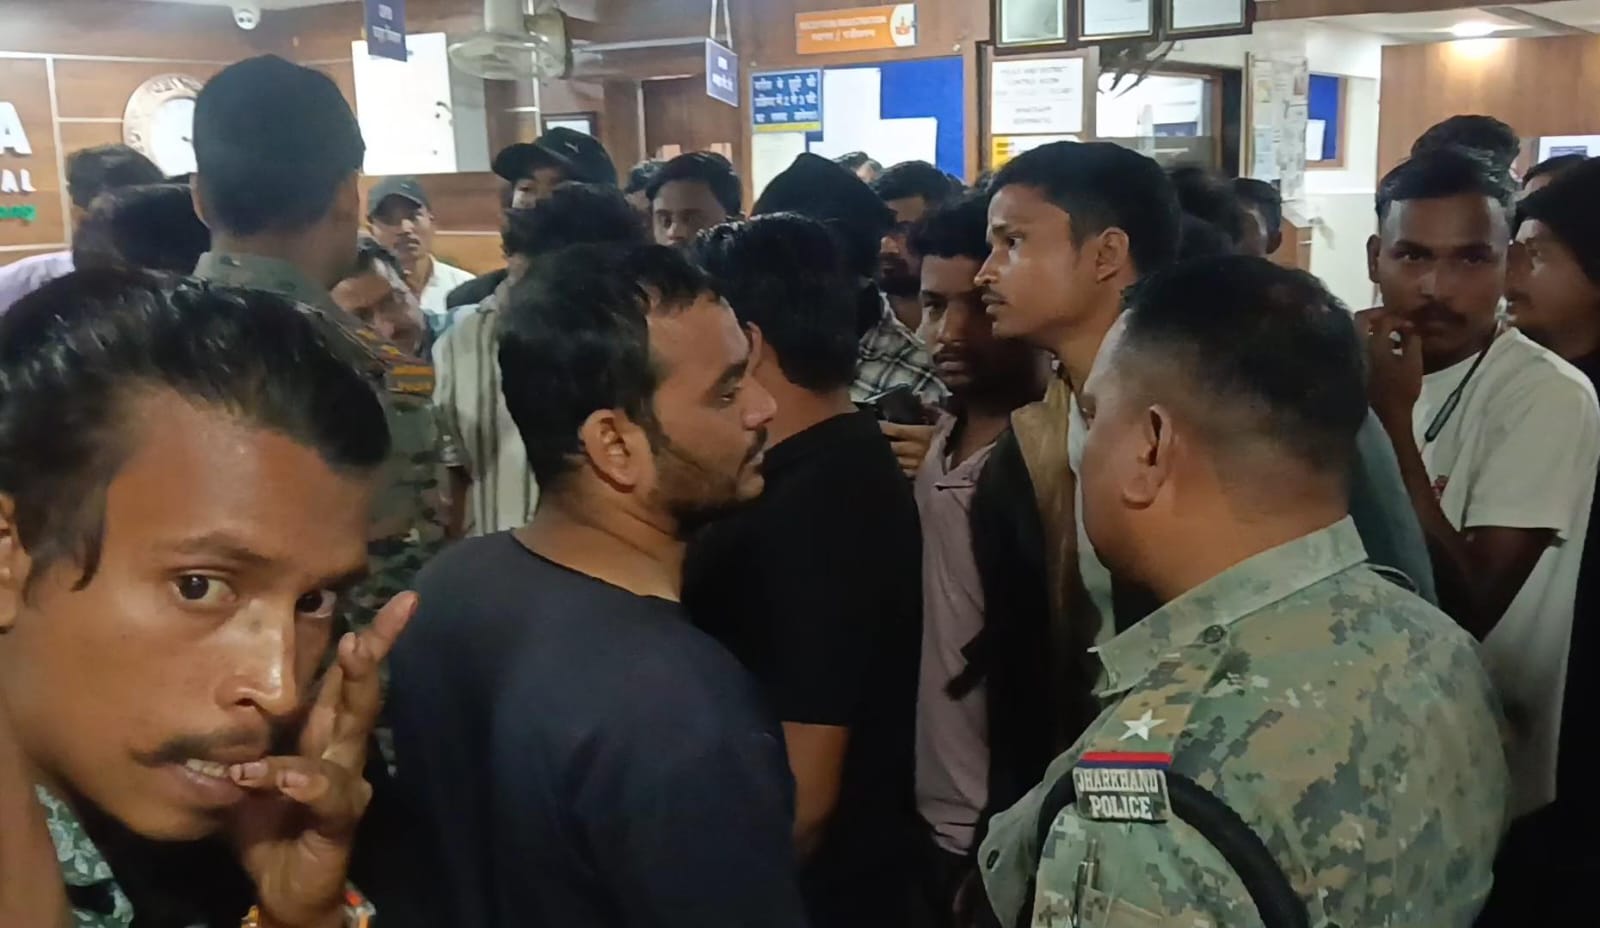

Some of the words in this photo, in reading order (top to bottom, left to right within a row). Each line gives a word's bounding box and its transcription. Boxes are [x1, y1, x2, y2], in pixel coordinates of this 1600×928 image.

[0, 101, 32, 154] A
[1077, 768, 1159, 794] JHARKHAND
[1089, 795, 1153, 820] POLICE
